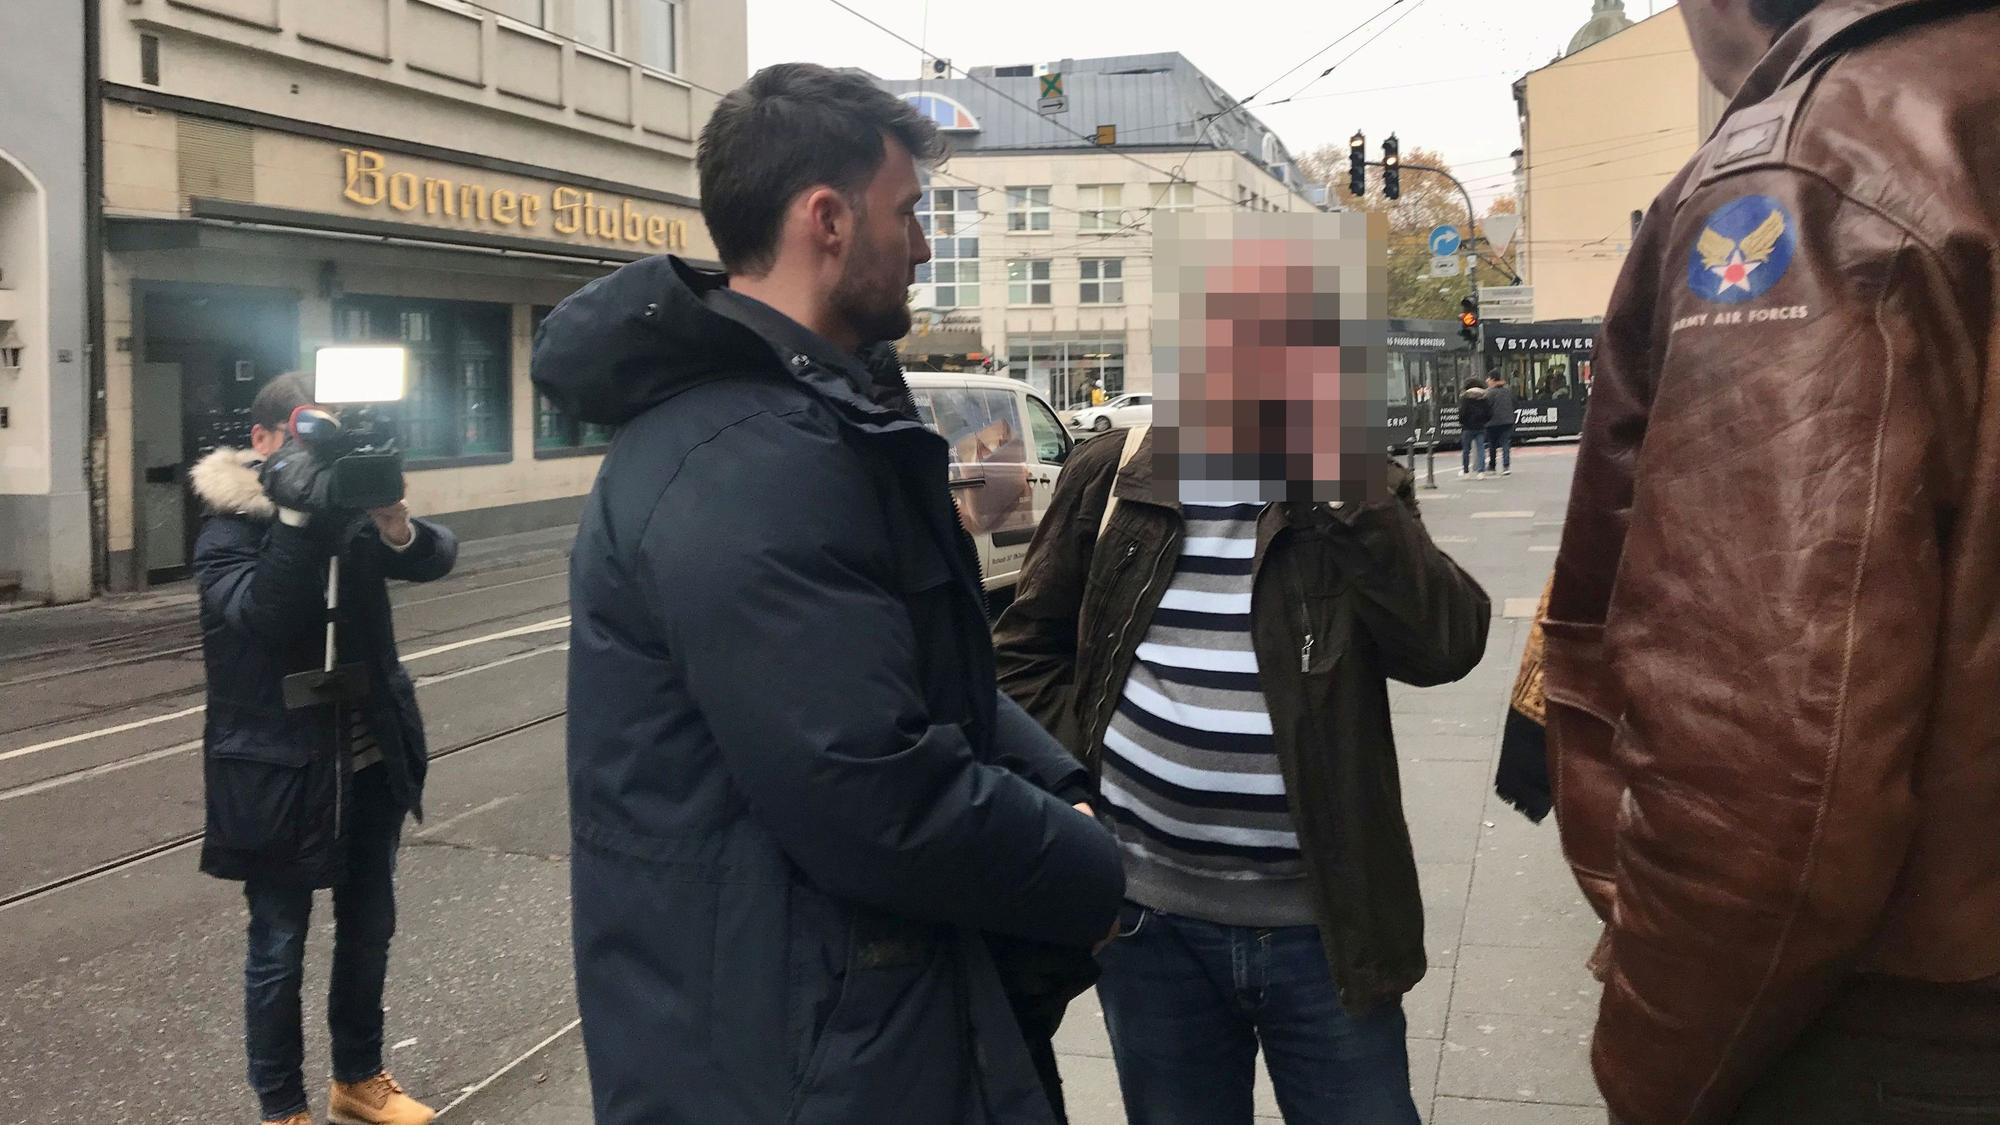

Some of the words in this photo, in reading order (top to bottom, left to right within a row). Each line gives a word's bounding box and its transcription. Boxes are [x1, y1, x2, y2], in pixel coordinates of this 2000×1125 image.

[340, 148, 542, 227] Bonner
[552, 186, 688, 250] Stuben
[1713, 311, 1742, 326] AIR
[1749, 306, 1808, 322] FORCES
[1508, 337, 1593, 349] STAHLWER
